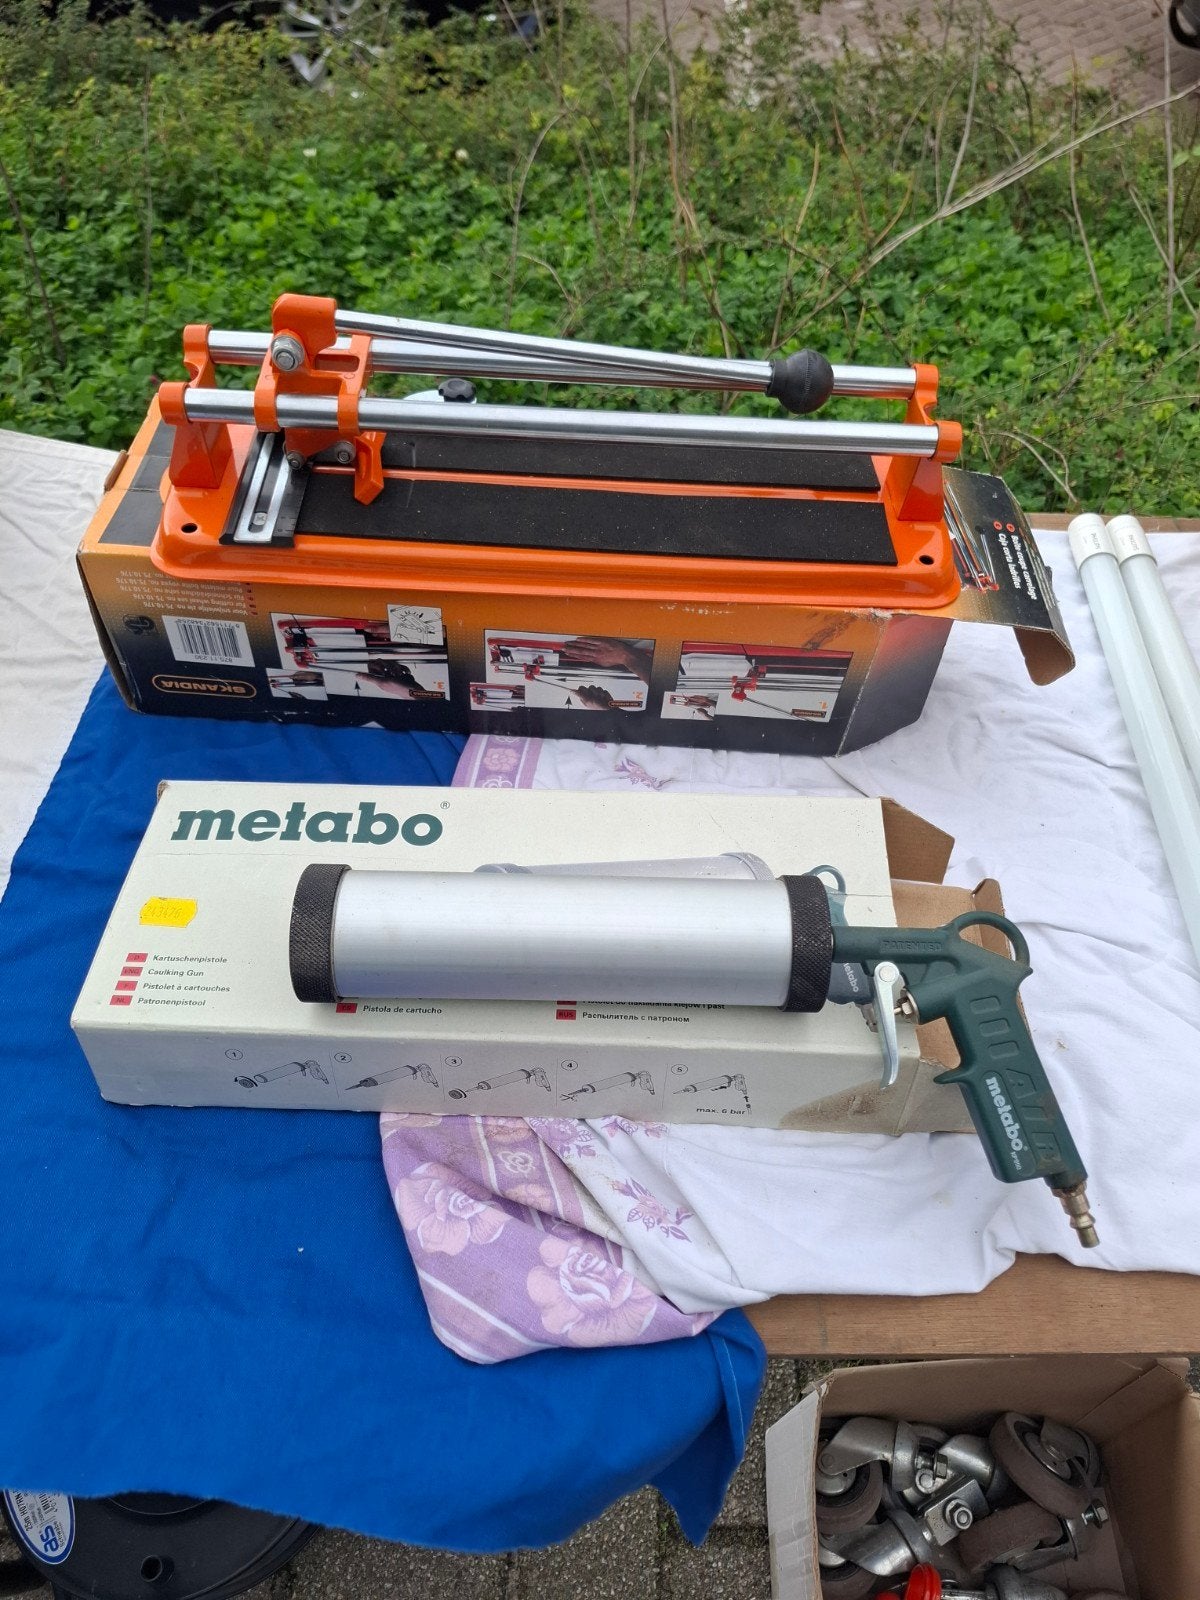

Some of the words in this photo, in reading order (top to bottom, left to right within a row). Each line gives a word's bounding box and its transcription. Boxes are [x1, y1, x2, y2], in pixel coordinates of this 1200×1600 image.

[160, 680, 247, 694] SKANDIA
[153, 954, 227, 963] Kartuschenpistole
[148, 969, 184, 977] Caulking
[137, 997, 206, 1006] Patronenpistool
[582, 1012, 639, 1021] Распылитель
[986, 1076, 1023, 1151] metabo
